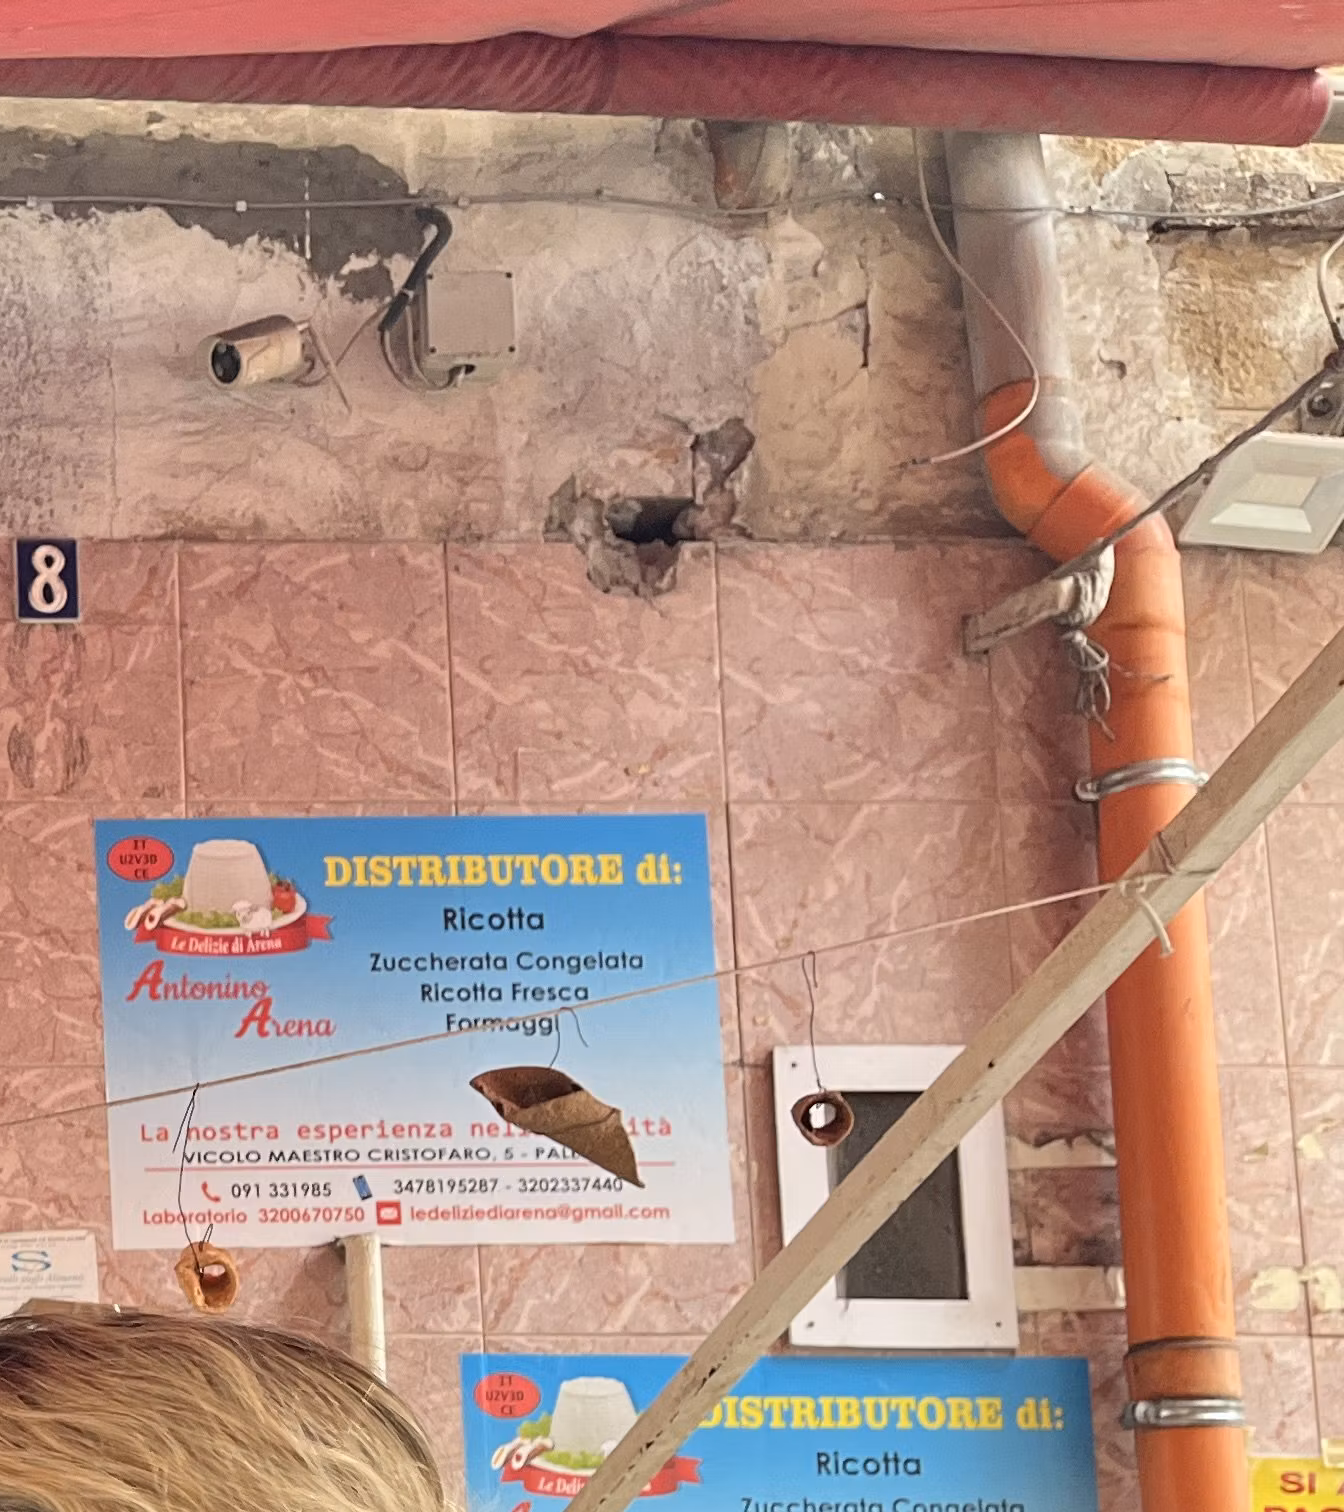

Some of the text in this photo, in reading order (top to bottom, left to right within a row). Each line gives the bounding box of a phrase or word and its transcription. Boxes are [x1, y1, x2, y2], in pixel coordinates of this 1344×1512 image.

[28, 544, 68, 614] 8
[323, 852, 683, 887] DISTRIBUTORE di:
[443, 907, 545, 932] Ricotta
[171, 936, 282, 954] Le Delizie di Arena
[370, 951, 644, 975] Zuccherata Congelata
[125, 960, 270, 1001] Antonino
[420, 981, 589, 1002] Ricotta Fresca
[234, 996, 336, 1039] Arena
[446, 1013, 560, 1035] Formaggi
[140, 1124, 170, 1143] La
[186, 1122, 279, 1141] nostra
[297, 1119, 453, 1144] esperienza
[184, 1150, 262, 1164] VICOLO
[268, 1149, 361, 1163] MAESTRO
[367, 1146, 497, 1162] CRISTOFARO,
[504, 1146, 514, 1160] 5
[231, 1184, 261, 1199] 091
[269, 1182, 332, 1198] 331985
[393, 1178, 499, 1195] 3478195287
[518, 1176, 624, 1194] 3202337440
[143, 1202, 671, 1225] Laboratorio 3200670750 ledeliziediarena@gmail.com
[1016, 1397, 1065, 1430] di:
[816, 1452, 922, 1476] Ricotta
[538, 1477, 553, 1490] Le
[1280, 1472, 1316, 1494] SI
